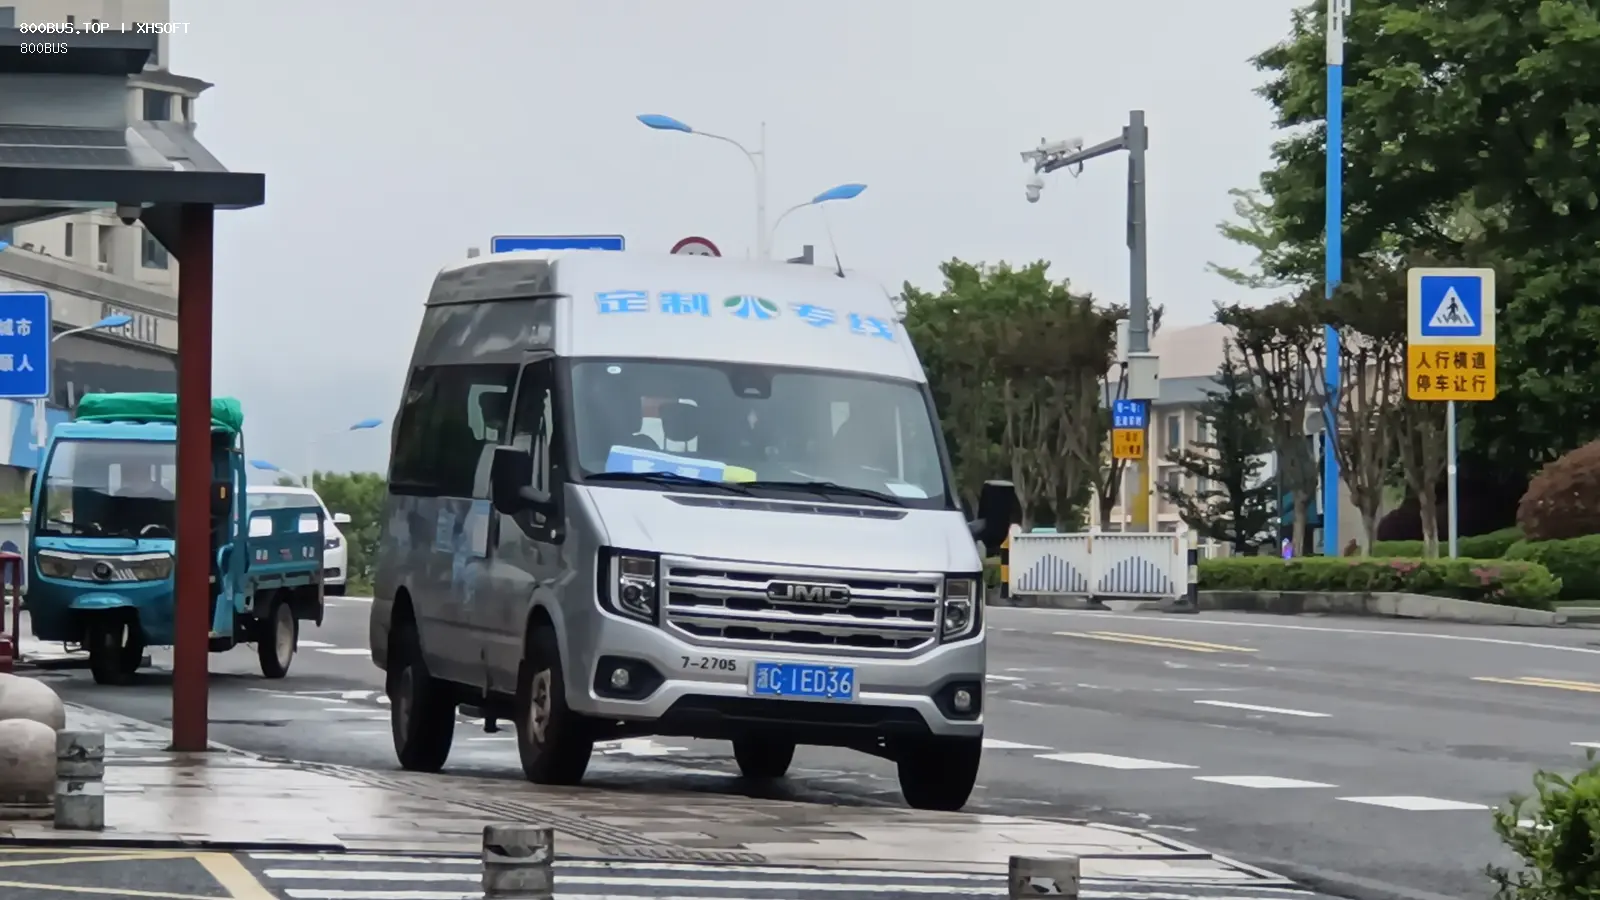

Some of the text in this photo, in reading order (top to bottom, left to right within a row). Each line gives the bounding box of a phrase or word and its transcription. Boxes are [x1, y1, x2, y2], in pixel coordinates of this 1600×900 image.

[1416, 351, 1486, 369] 人行横道
[1416, 374, 1487, 393] 停车让行
[768, 585, 849, 602] JMC
[681, 656, 737, 671] 7-2705
